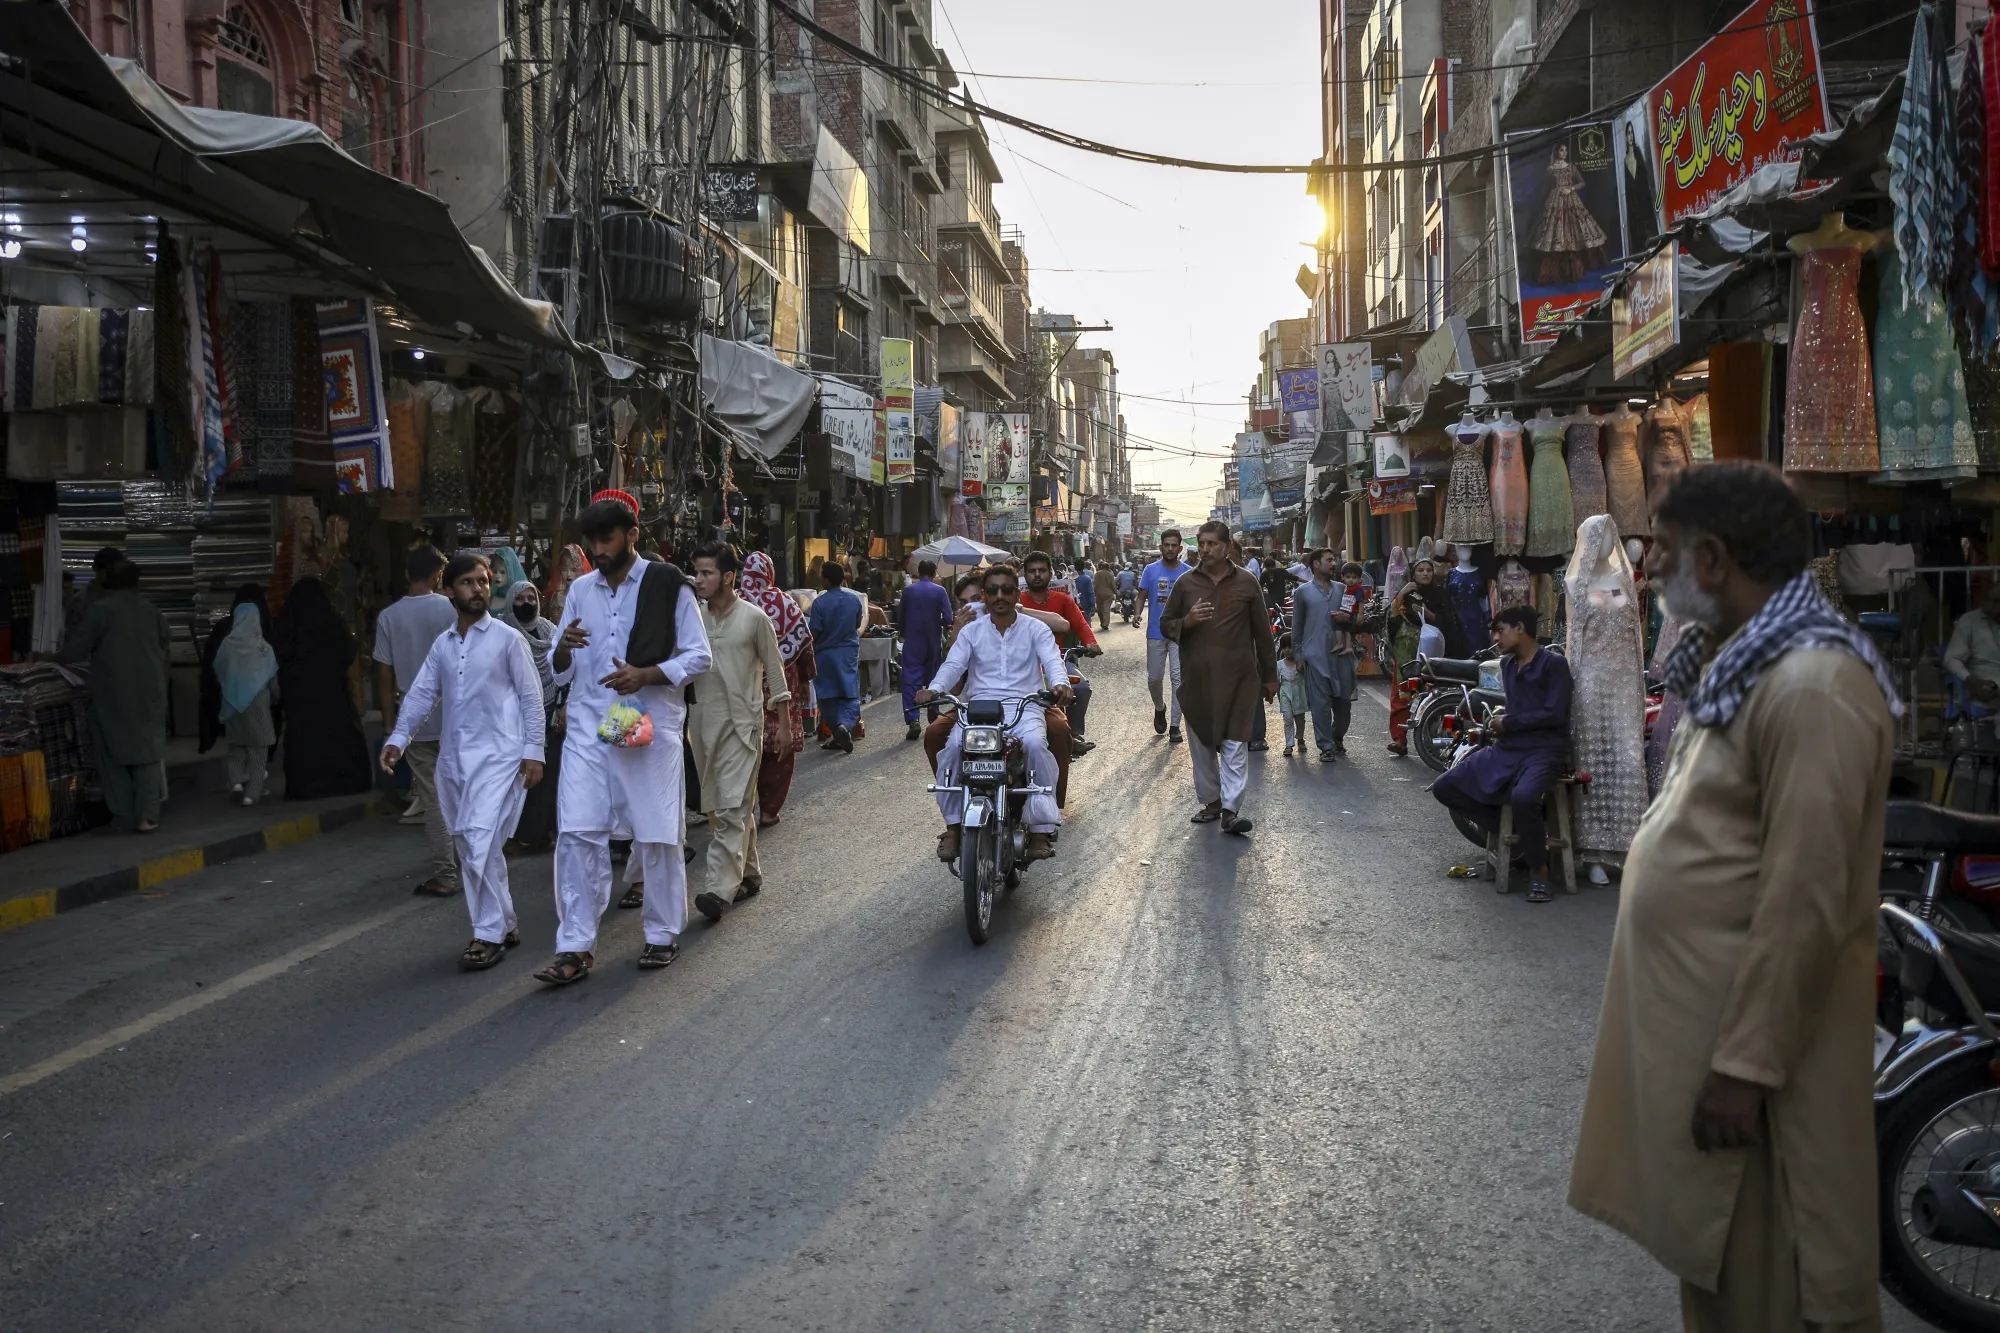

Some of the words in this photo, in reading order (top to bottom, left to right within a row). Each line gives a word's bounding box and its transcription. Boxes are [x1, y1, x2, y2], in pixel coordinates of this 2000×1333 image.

[1675, 61, 1719, 189] سلک
[1716, 69, 1767, 166] وحید
[1654, 89, 1687, 212] سنٹر
[1342, 374, 1365, 403] رانی
[1343, 346, 1369, 372] بہو
[823, 414, 845, 437] GREAT
